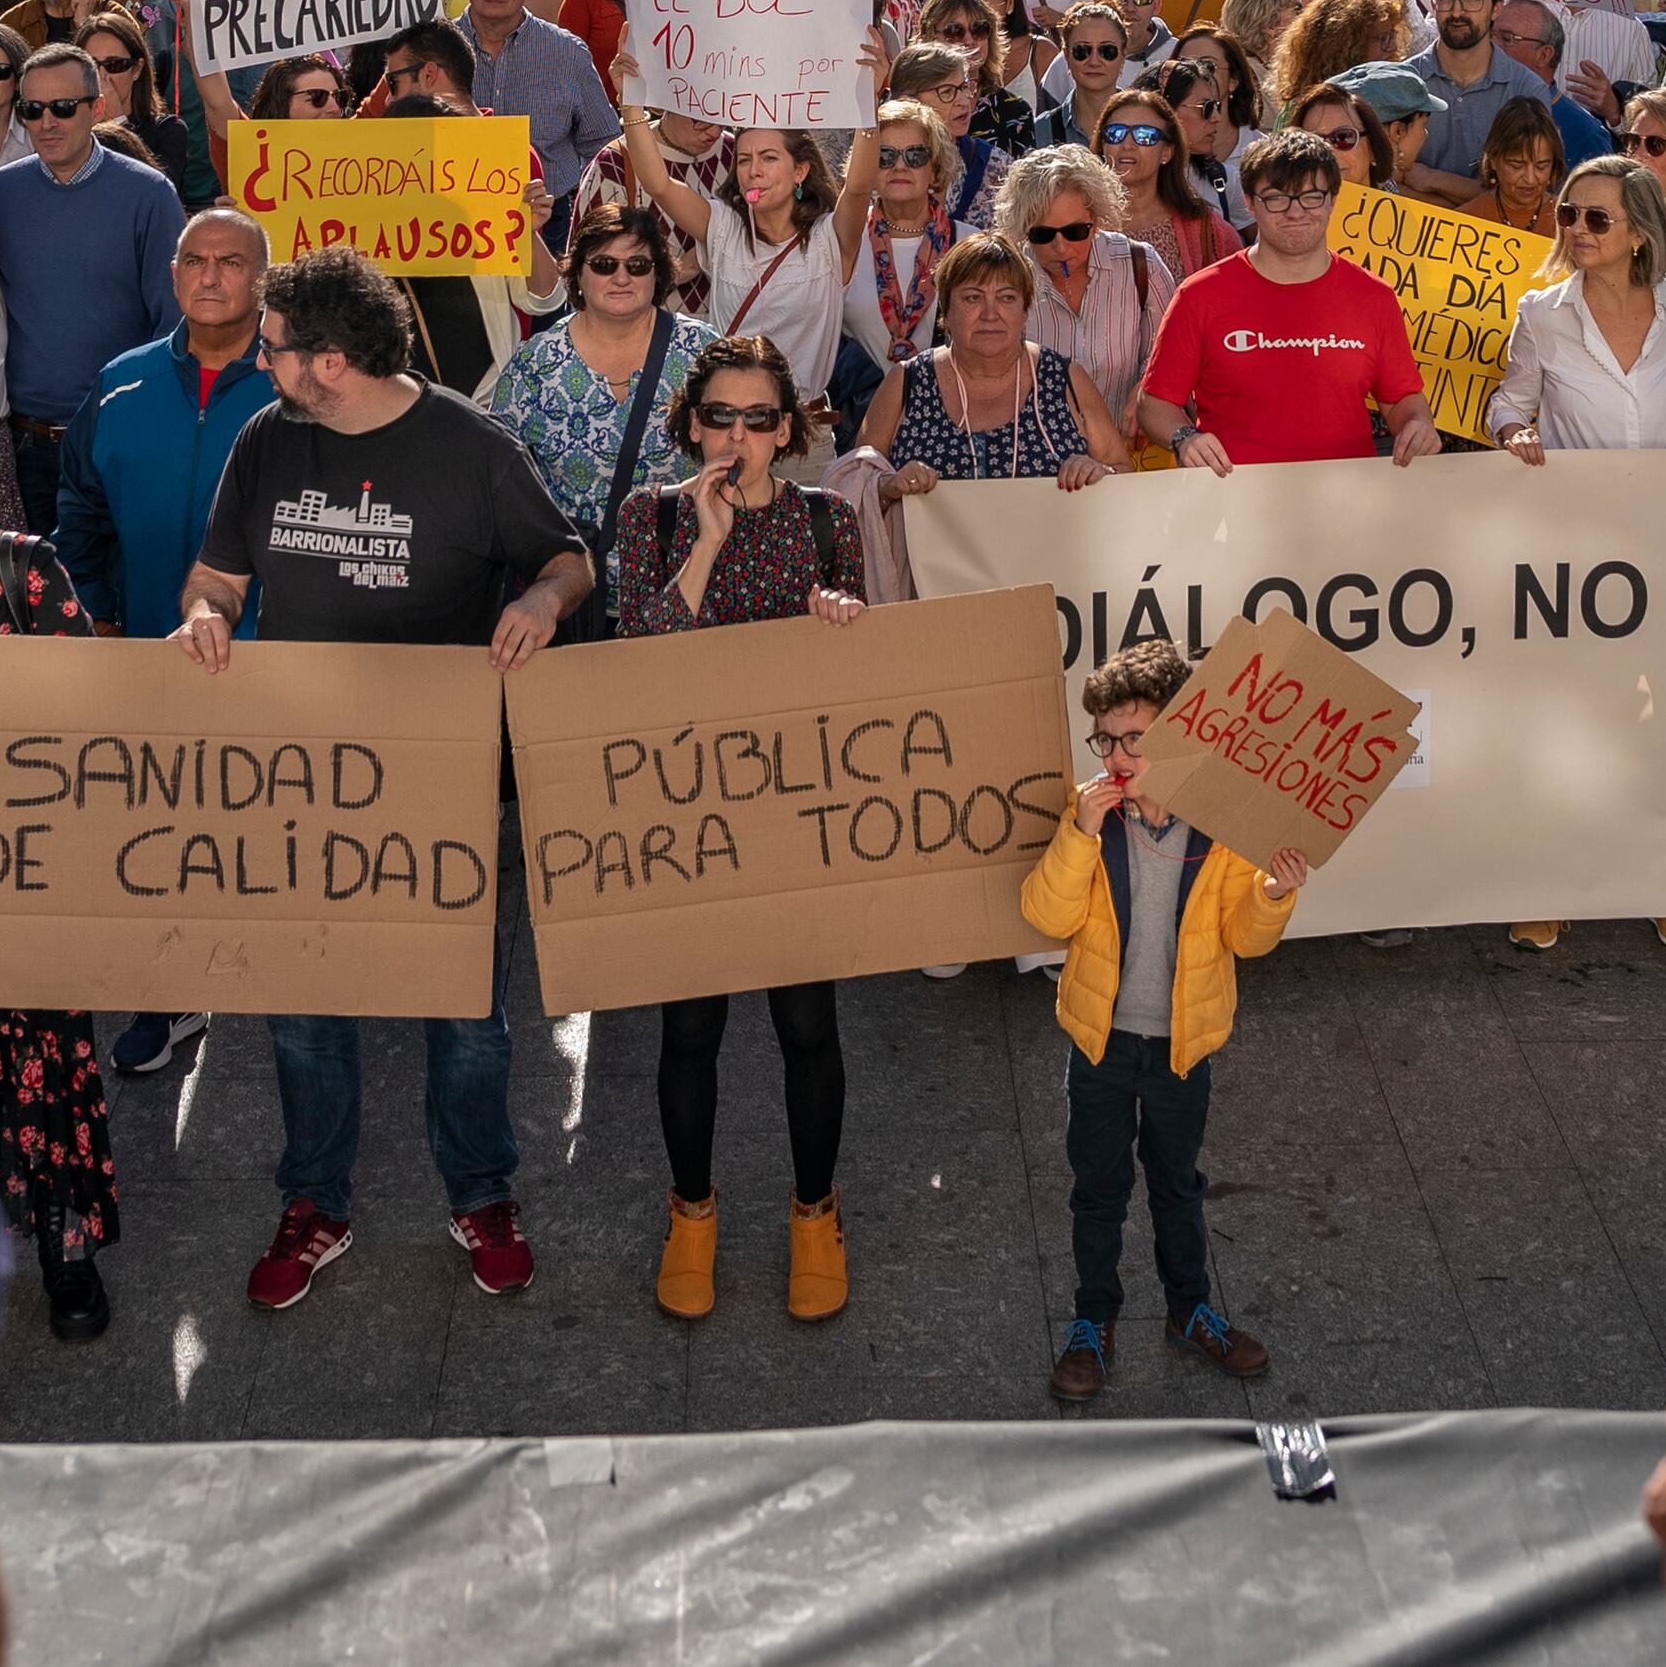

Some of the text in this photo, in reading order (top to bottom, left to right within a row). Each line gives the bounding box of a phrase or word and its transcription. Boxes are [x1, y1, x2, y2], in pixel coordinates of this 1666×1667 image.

[652, 20, 845, 90] 10 mins por
[667, 76, 831, 126] PACIENTE
[243, 128, 522, 213] ¿RECORDÁIS LOS
[292, 209, 526, 264] APLAUSOS?
[1341, 192, 1522, 276] ¿QUIERES
[1445, 272, 1507, 320] DÍA
[1223, 329, 1366, 357] Champion
[269, 526, 411, 560] BARRIONALISTA
[1512, 556, 1650, 642] NO
[601, 710, 956, 807] PÚBLICA
[1165, 688, 1369, 832] AGRESIONES
[1227, 652, 1399, 791] NO MÁS
[4, 735, 387, 813] SANIDAD
[113, 817, 490, 911] CALIDAD
[540, 768, 1066, 907] PARA TODOS
